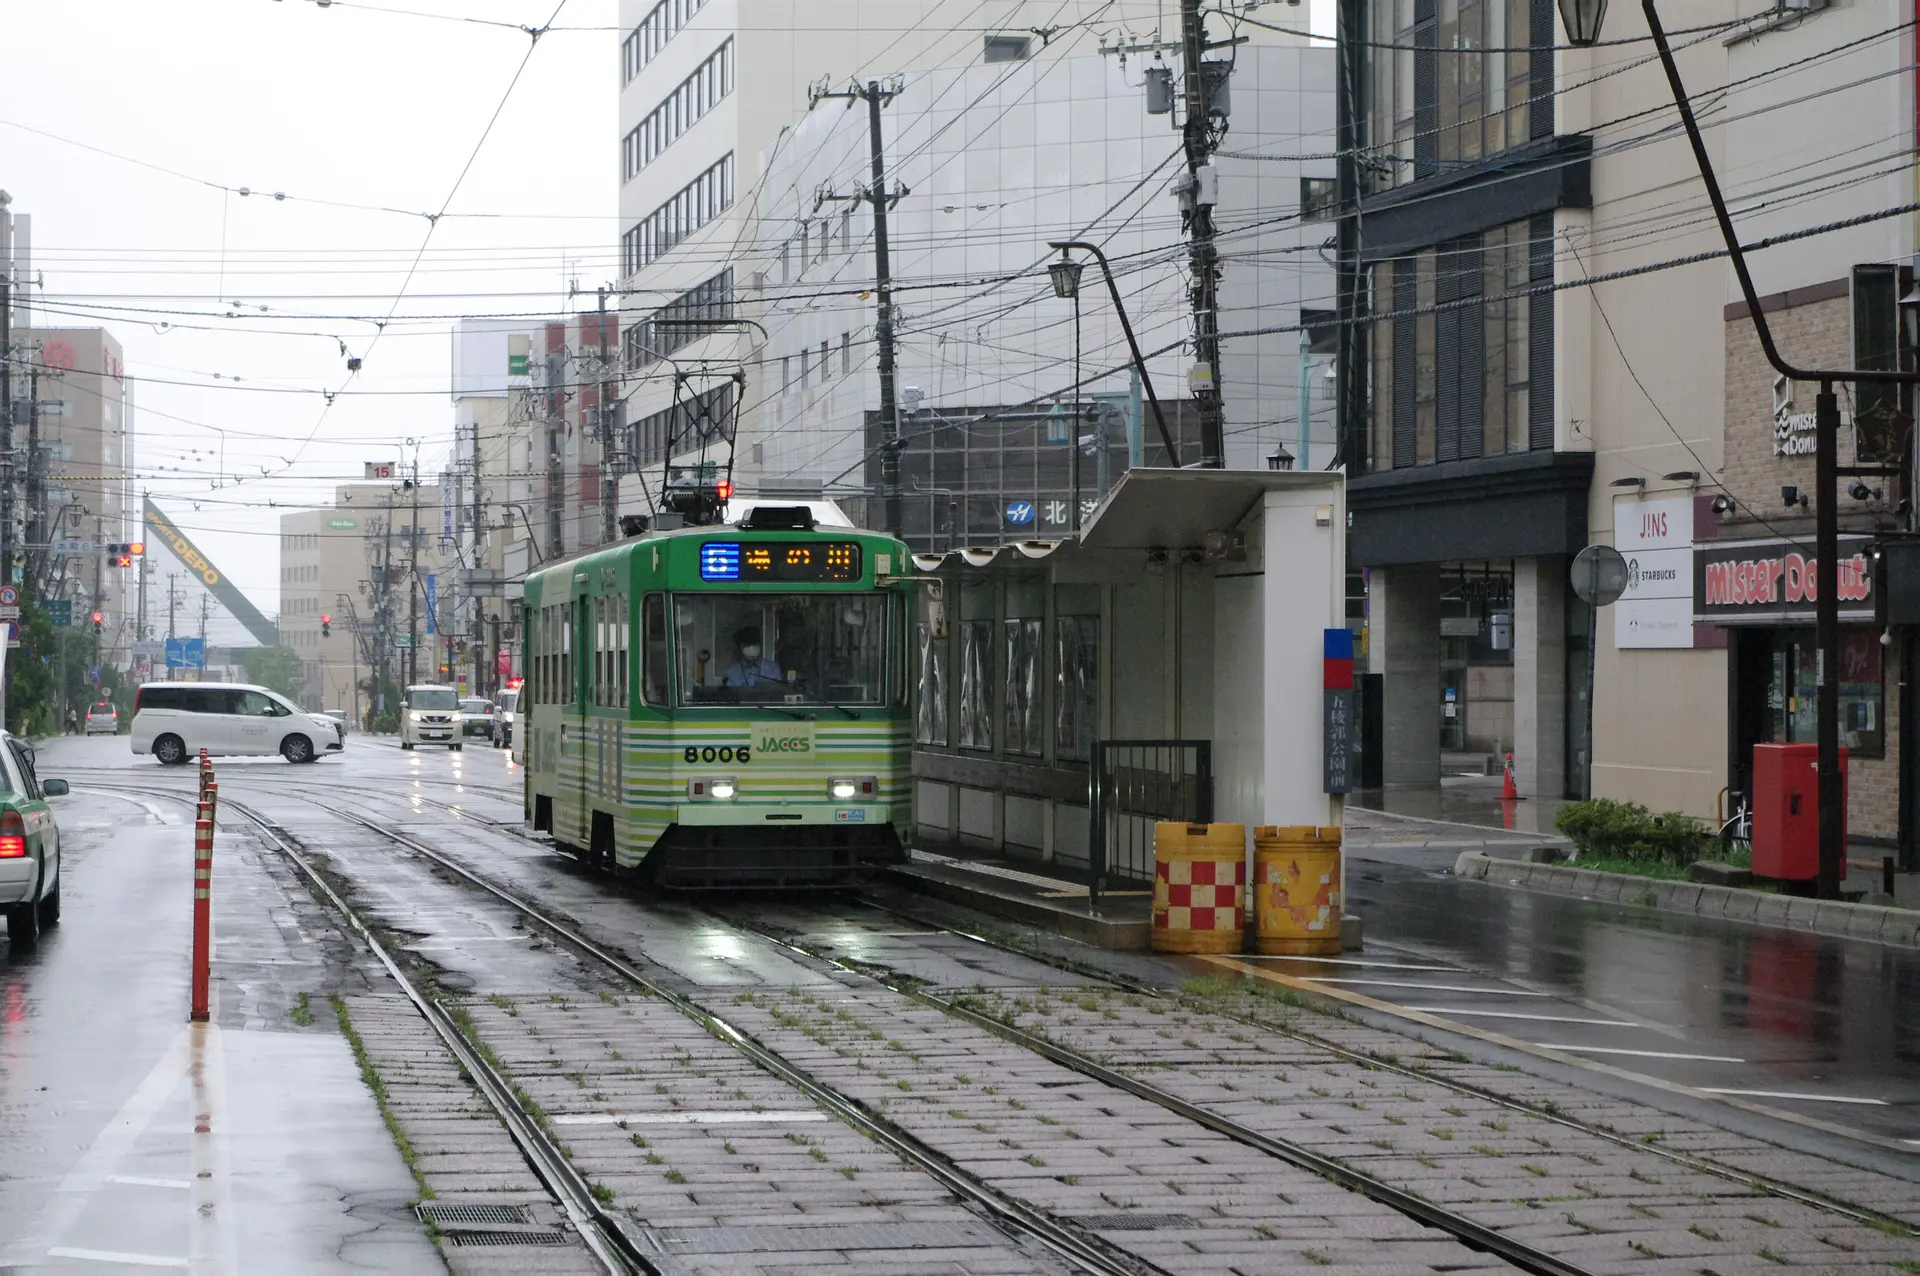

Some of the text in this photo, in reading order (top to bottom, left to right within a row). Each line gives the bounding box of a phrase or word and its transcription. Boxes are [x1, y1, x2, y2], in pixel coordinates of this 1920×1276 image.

[1790, 436, 1817, 455] Donu
[374, 466, 390, 479] 15
[173, 537, 218, 585] DEPO
[1641, 569, 1676, 581] STARBUCKS
[1785, 552, 1872, 603] Dout
[684, 737, 811, 764] 8006 JACCS
